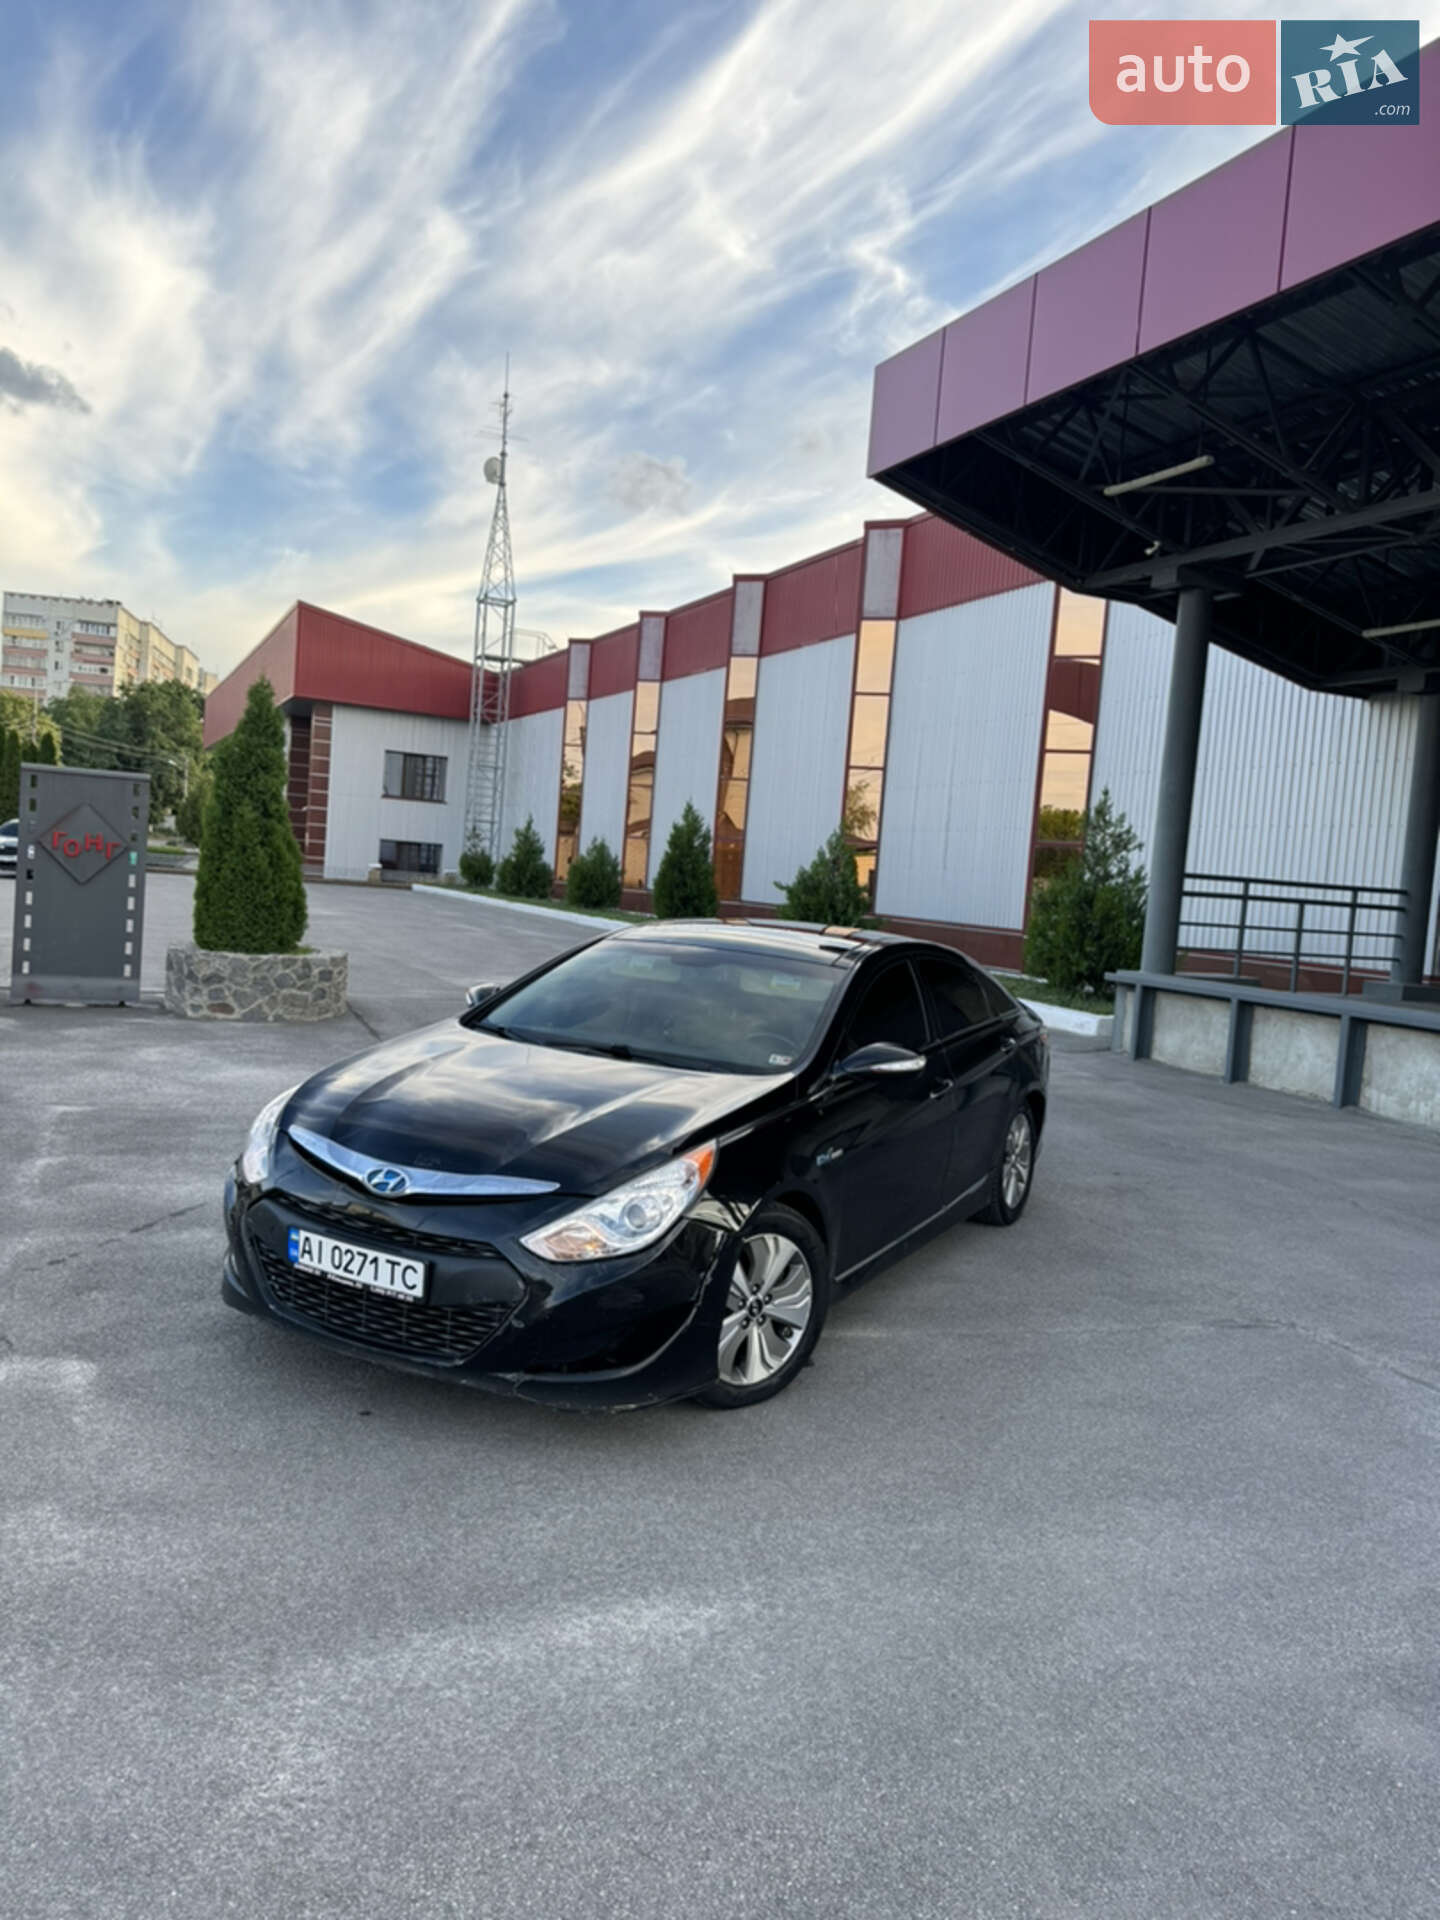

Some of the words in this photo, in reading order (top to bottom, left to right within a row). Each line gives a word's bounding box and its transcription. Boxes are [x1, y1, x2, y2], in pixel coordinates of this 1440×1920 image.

[300, 1236, 323, 1265] AI
[330, 1245, 379, 1281] 0271
[385, 1259, 419, 1290] TC
